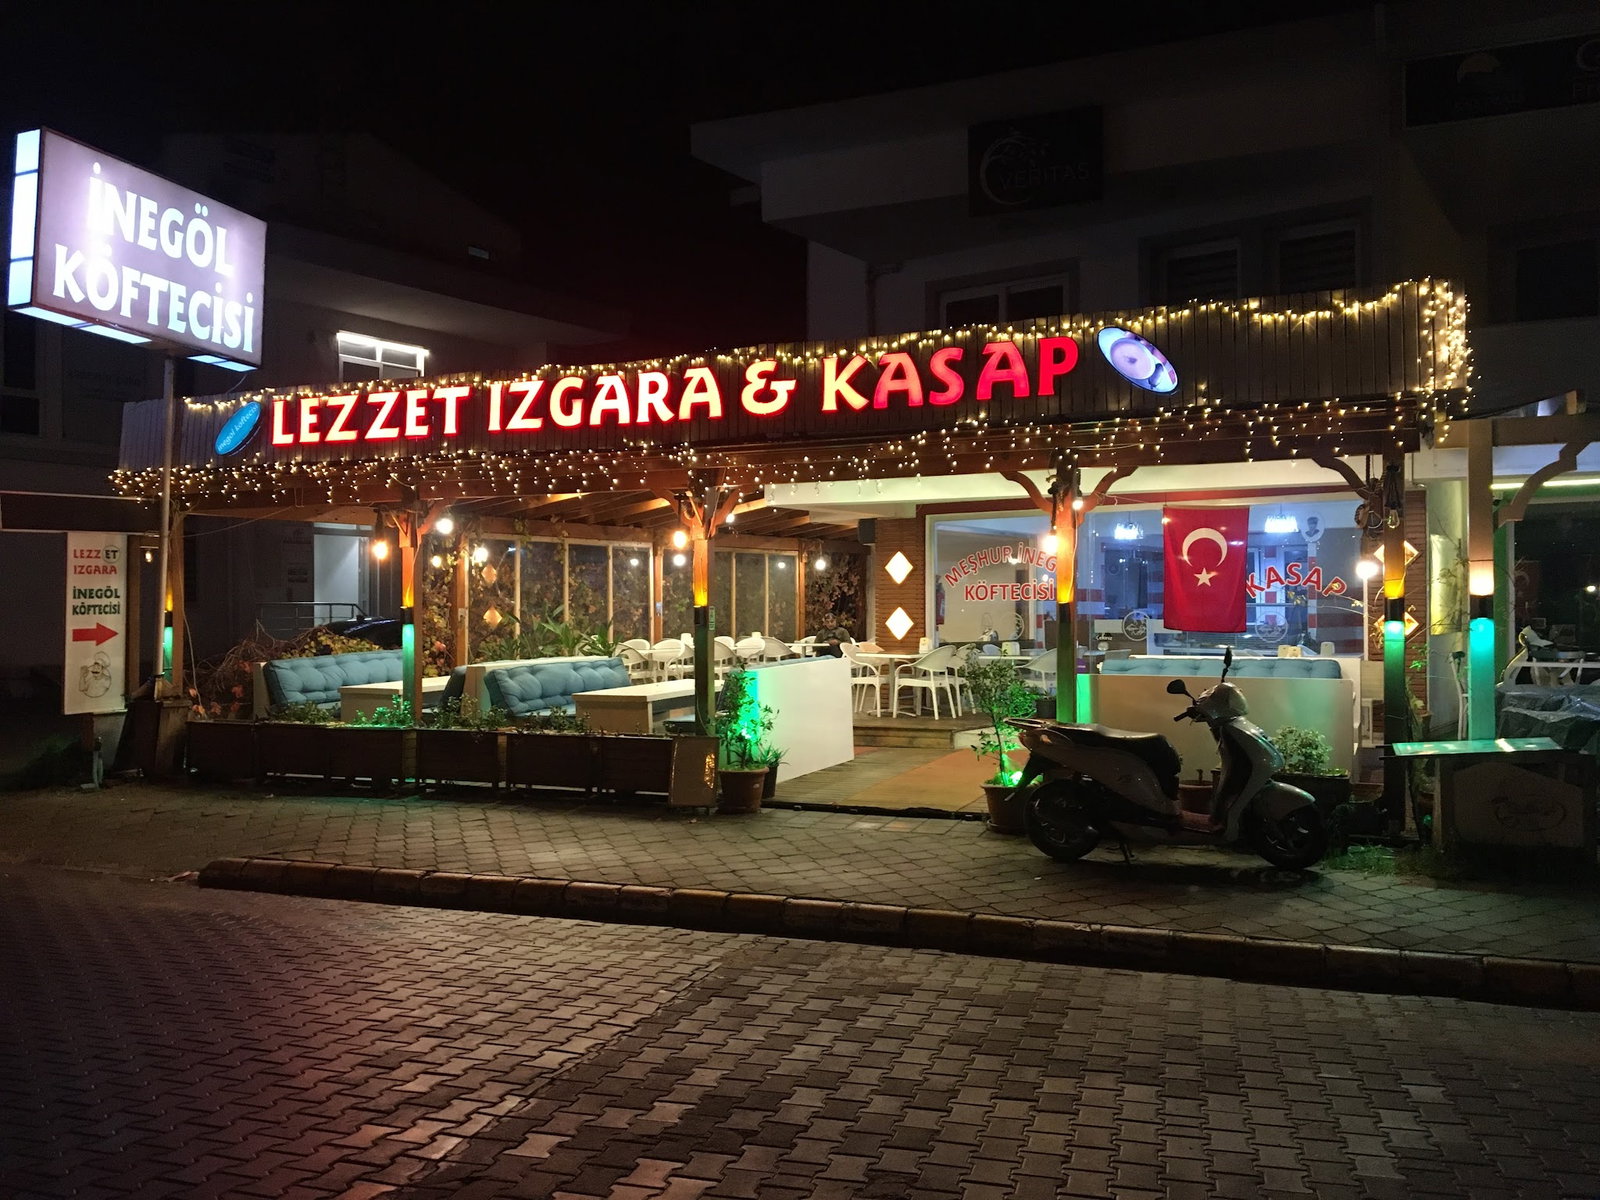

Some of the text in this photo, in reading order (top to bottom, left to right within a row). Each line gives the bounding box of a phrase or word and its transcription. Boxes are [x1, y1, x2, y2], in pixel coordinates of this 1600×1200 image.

[88, 162, 233, 278] İNEGÖL
[53, 243, 255, 353] KÖFTECİSİ
[271, 335, 1079, 447] LEZZET IZGARA & KASAP
[73, 565, 117, 575] IZGARA
[944, 541, 1057, 587] MEŞHUR İNEG
[1246, 562, 1347, 598] KASAP
[72, 586, 121, 600] İNEGÖL
[964, 578, 1055, 601] KÖFTECİSİ
[72, 601, 120, 616] KÖFTECİSİ
